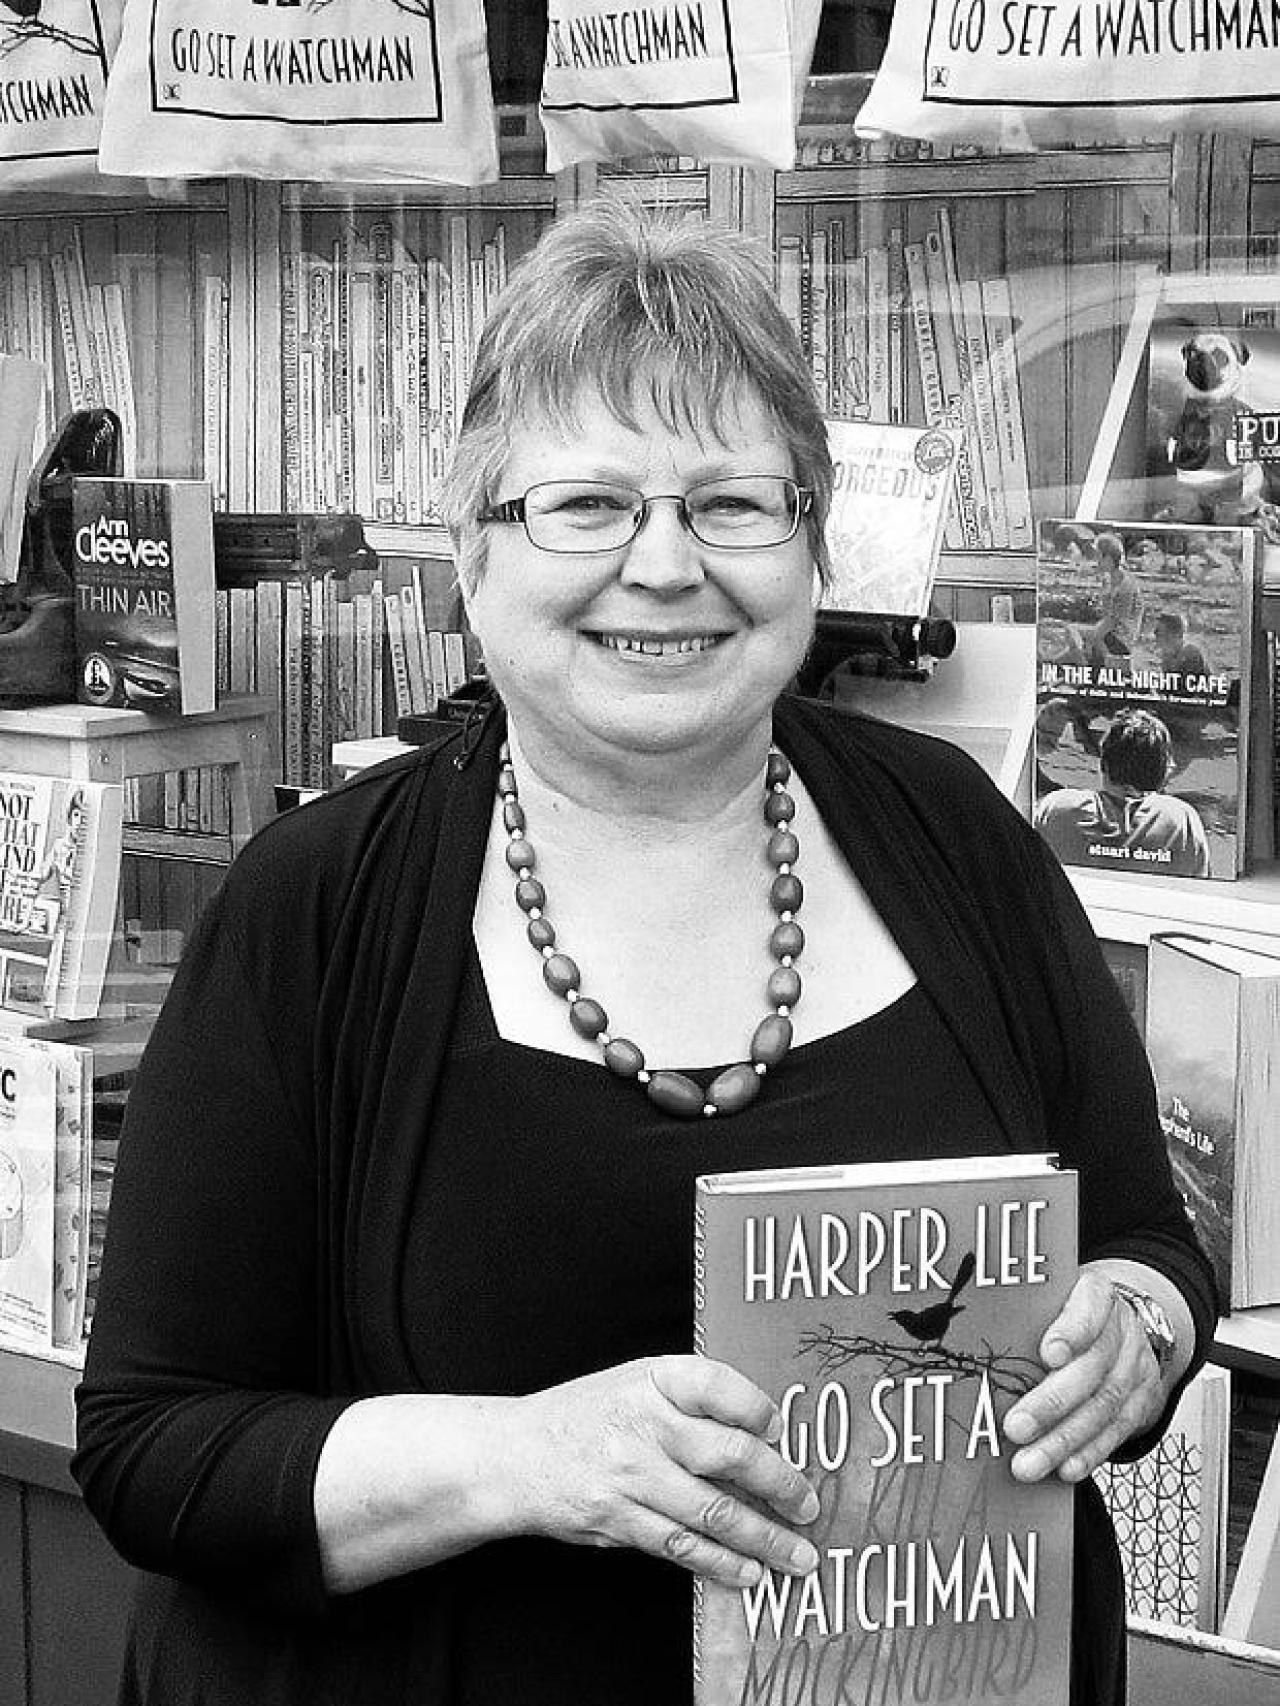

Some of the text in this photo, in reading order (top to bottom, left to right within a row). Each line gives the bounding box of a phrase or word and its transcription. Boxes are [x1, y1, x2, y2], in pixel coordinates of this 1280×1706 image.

[568, 20, 586, 68] A
[576, 2, 708, 68] WATCHMAN
[949, 0, 986, 52] GO
[997, 1, 1056, 56] SET
[1060, 4, 1082, 56] A
[172, 28, 414, 85] GO SET A WATCHMAN
[76, 522, 170, 568] Cleeves
[76, 584, 172, 617] THIN AIR
[1042, 663, 1228, 695] IN THE ALL-NIGHT CAFÉ
[745, 1201, 1048, 1301] HARPER LEE
[780, 1369, 1000, 1471] GO SET A
[742, 1531, 1038, 1641] WATCHMAN
